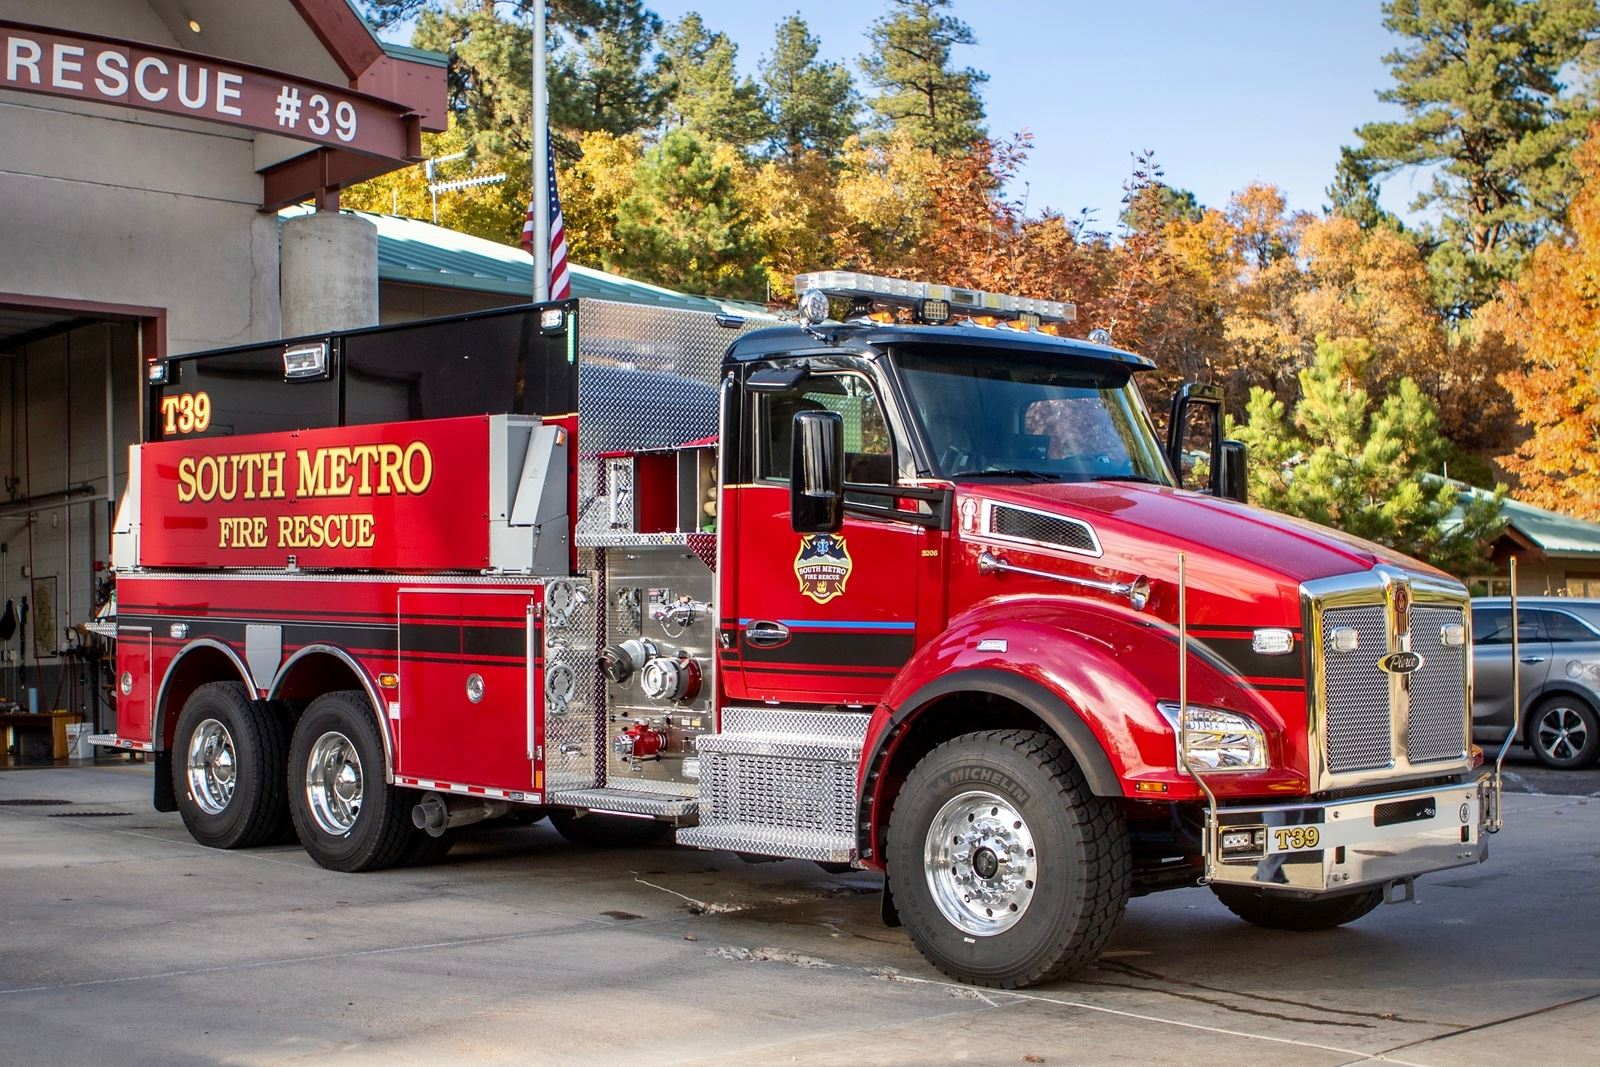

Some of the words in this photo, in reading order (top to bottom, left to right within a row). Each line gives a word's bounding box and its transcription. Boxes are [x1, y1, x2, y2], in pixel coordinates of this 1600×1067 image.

[7, 36, 243, 116] RESCUE
[275, 85, 356, 142] #39
[160, 391, 211, 434] T39
[177, 450, 287, 502] SOUTH
[296, 440, 433, 497] METRO
[218, 516, 268, 548] FIRE
[277, 513, 376, 548] RESCUE
[799, 565, 821, 575] SOUTH
[822, 565, 846, 575] METRO
[950, 767, 1029, 802] MICHELIN
[1274, 826, 1320, 850] T39
